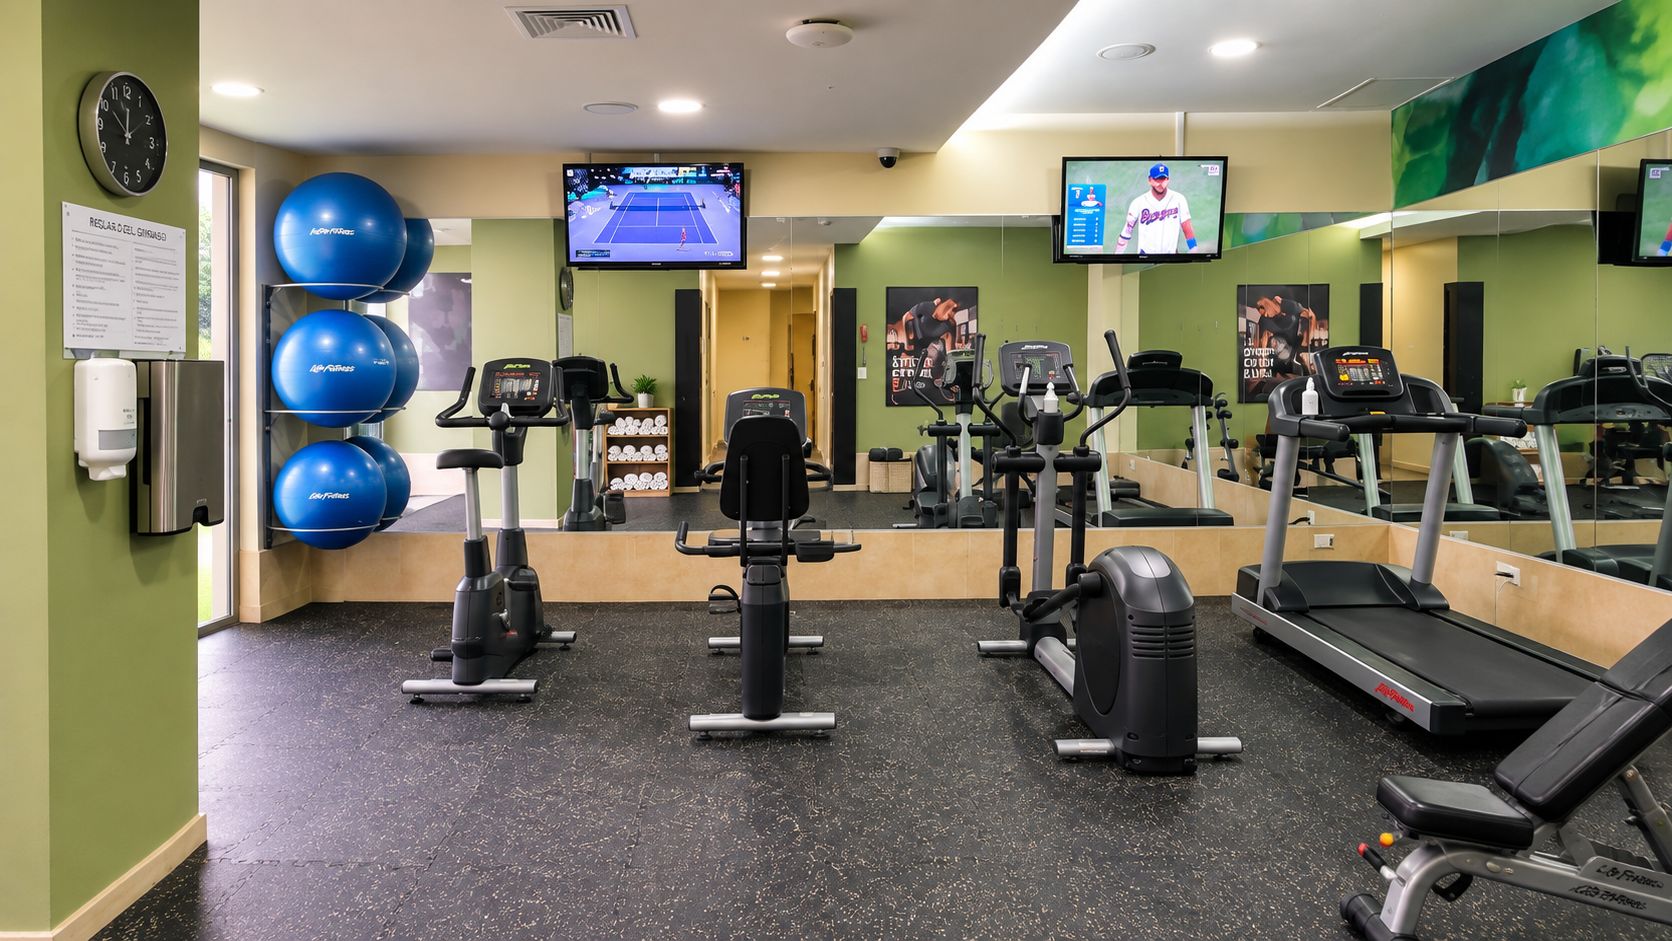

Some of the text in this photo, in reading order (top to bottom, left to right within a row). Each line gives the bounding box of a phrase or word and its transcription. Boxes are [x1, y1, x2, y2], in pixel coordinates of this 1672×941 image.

[111, 86, 118, 100] 11
[123, 84, 132, 100] 12
[100, 99, 109, 112] 10
[97, 117, 104, 130] 9
[145, 114, 151, 126] 2
[149, 136, 155, 149] 3
[111, 161, 117, 174] 7
[123, 172, 129, 186] 6
[136, 169, 142, 183] 5
